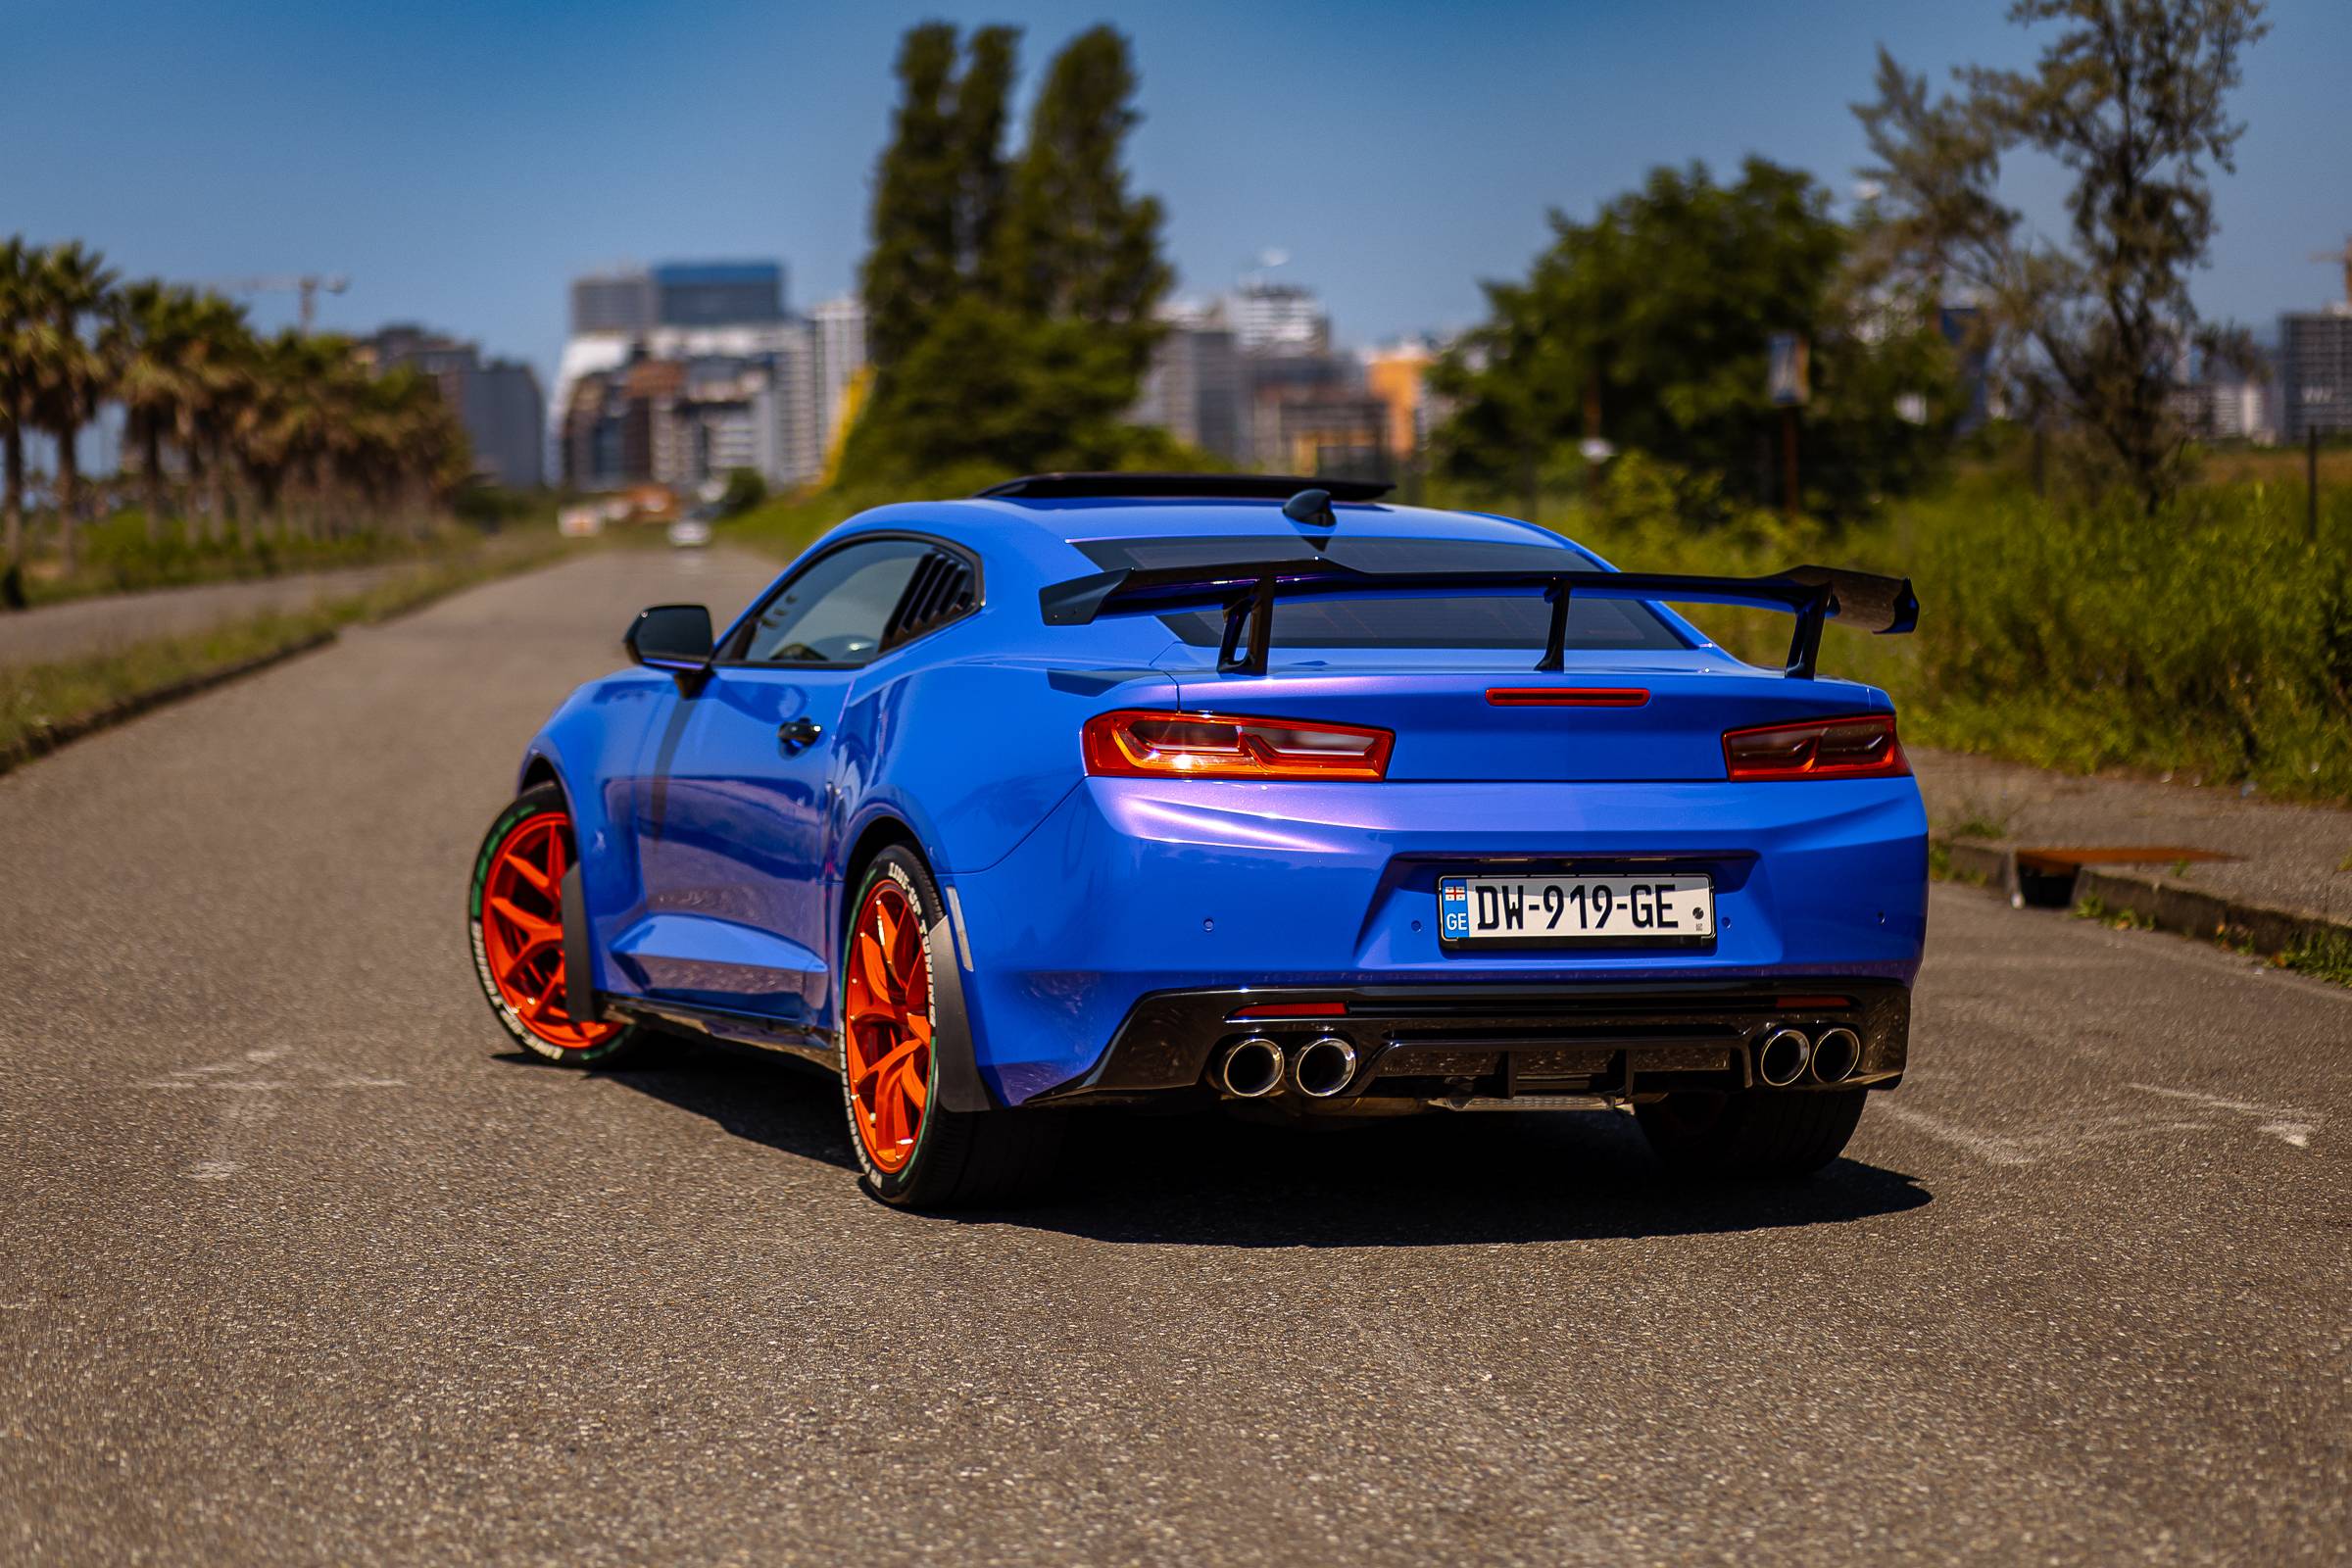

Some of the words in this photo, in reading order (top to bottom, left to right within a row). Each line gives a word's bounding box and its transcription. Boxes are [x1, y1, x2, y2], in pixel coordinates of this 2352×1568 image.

[1446, 912, 1468, 931] GE
[1475, 884, 1680, 930] DW-919-GE
[919, 919, 936, 1028] TUNING
